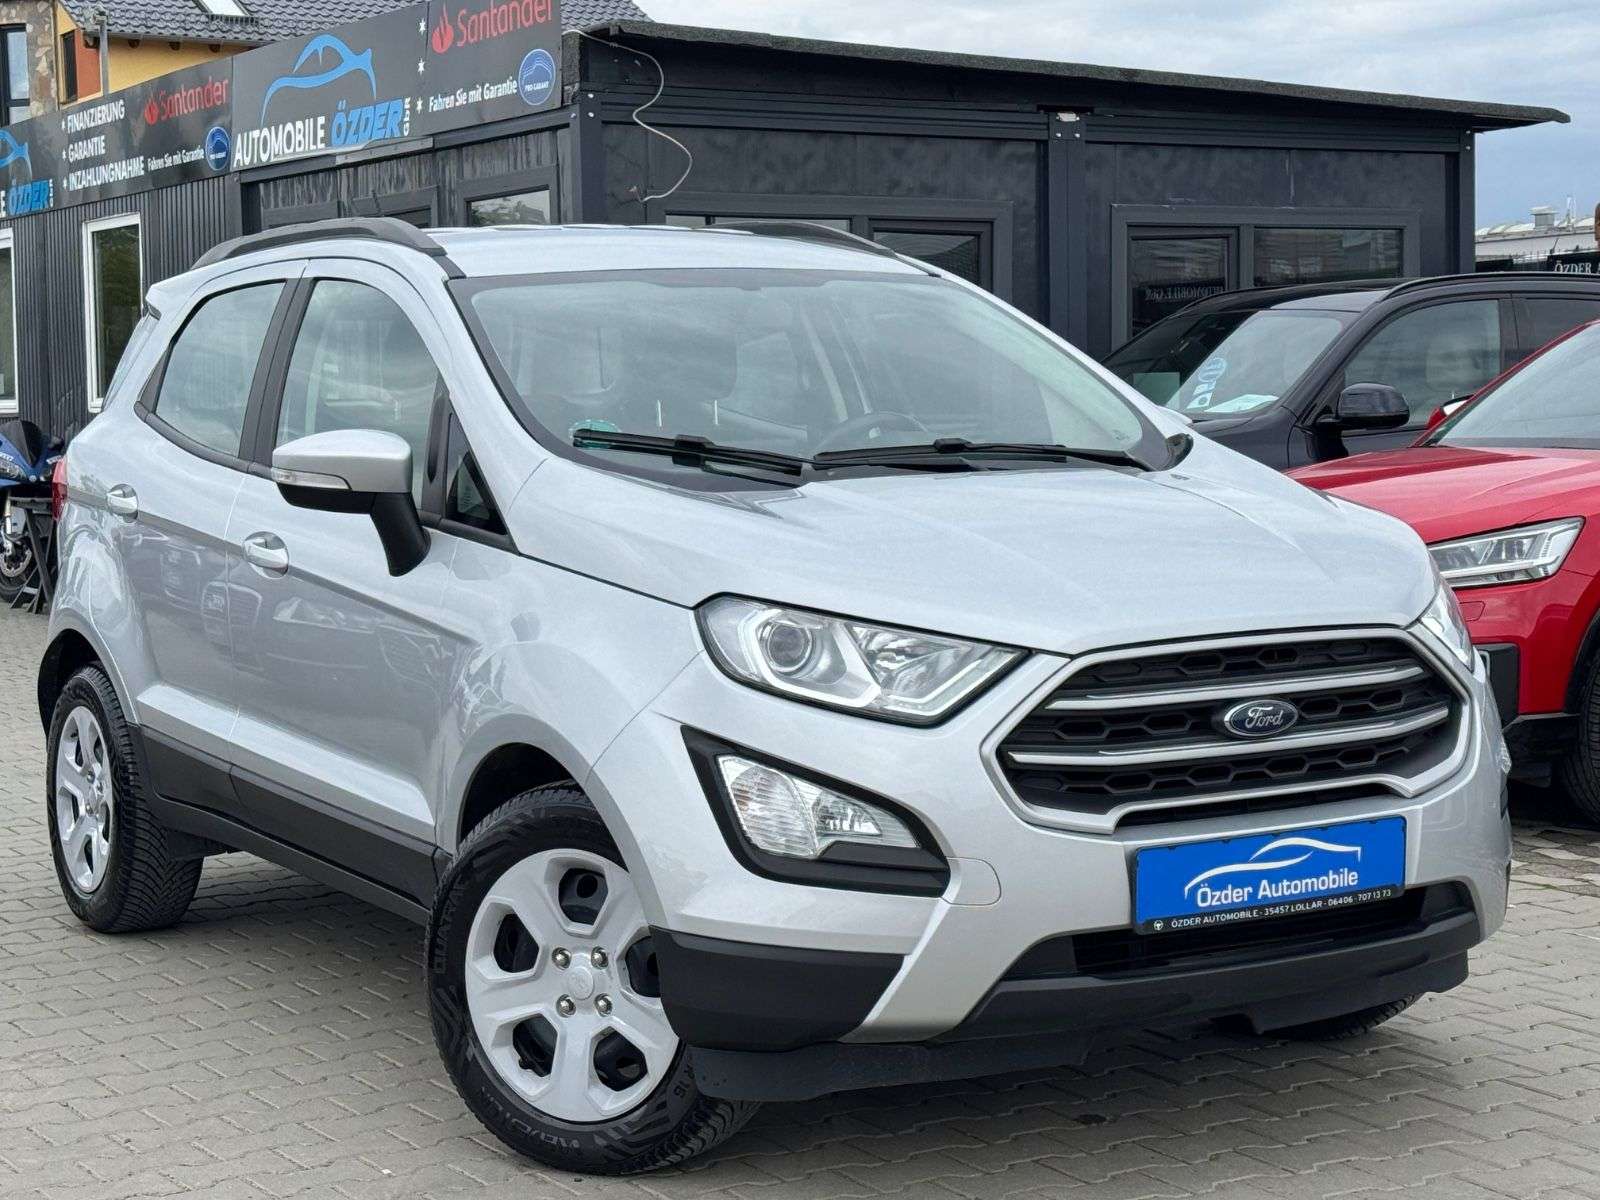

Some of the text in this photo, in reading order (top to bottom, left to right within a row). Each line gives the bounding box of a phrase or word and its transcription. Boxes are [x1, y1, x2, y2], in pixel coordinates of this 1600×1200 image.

[456, 0, 552, 47] Santander
[160, 75, 228, 121] Santander
[429, 75, 518, 113] Fahren Sie mit Garantie
[67, 99, 125, 133] FINANZIERUNG
[232, 115, 326, 168] AUTOMOBILE
[331, 98, 403, 147] ÖZDER
[68, 135, 105, 163] GARANTIE
[69, 155, 145, 192] INZAHLUNGNAHME
[1554, 260, 1592, 275] ÖZDER
[1245, 706, 1284, 729] Ford
[1197, 867, 1358, 908] Özder Automobile
[1171, 918, 1201, 928] ÖZDER
[1264, 904, 1290, 916] 35457
[1291, 900, 1323, 912] LOLLAR
[1328, 895, 1353, 907] 06406
